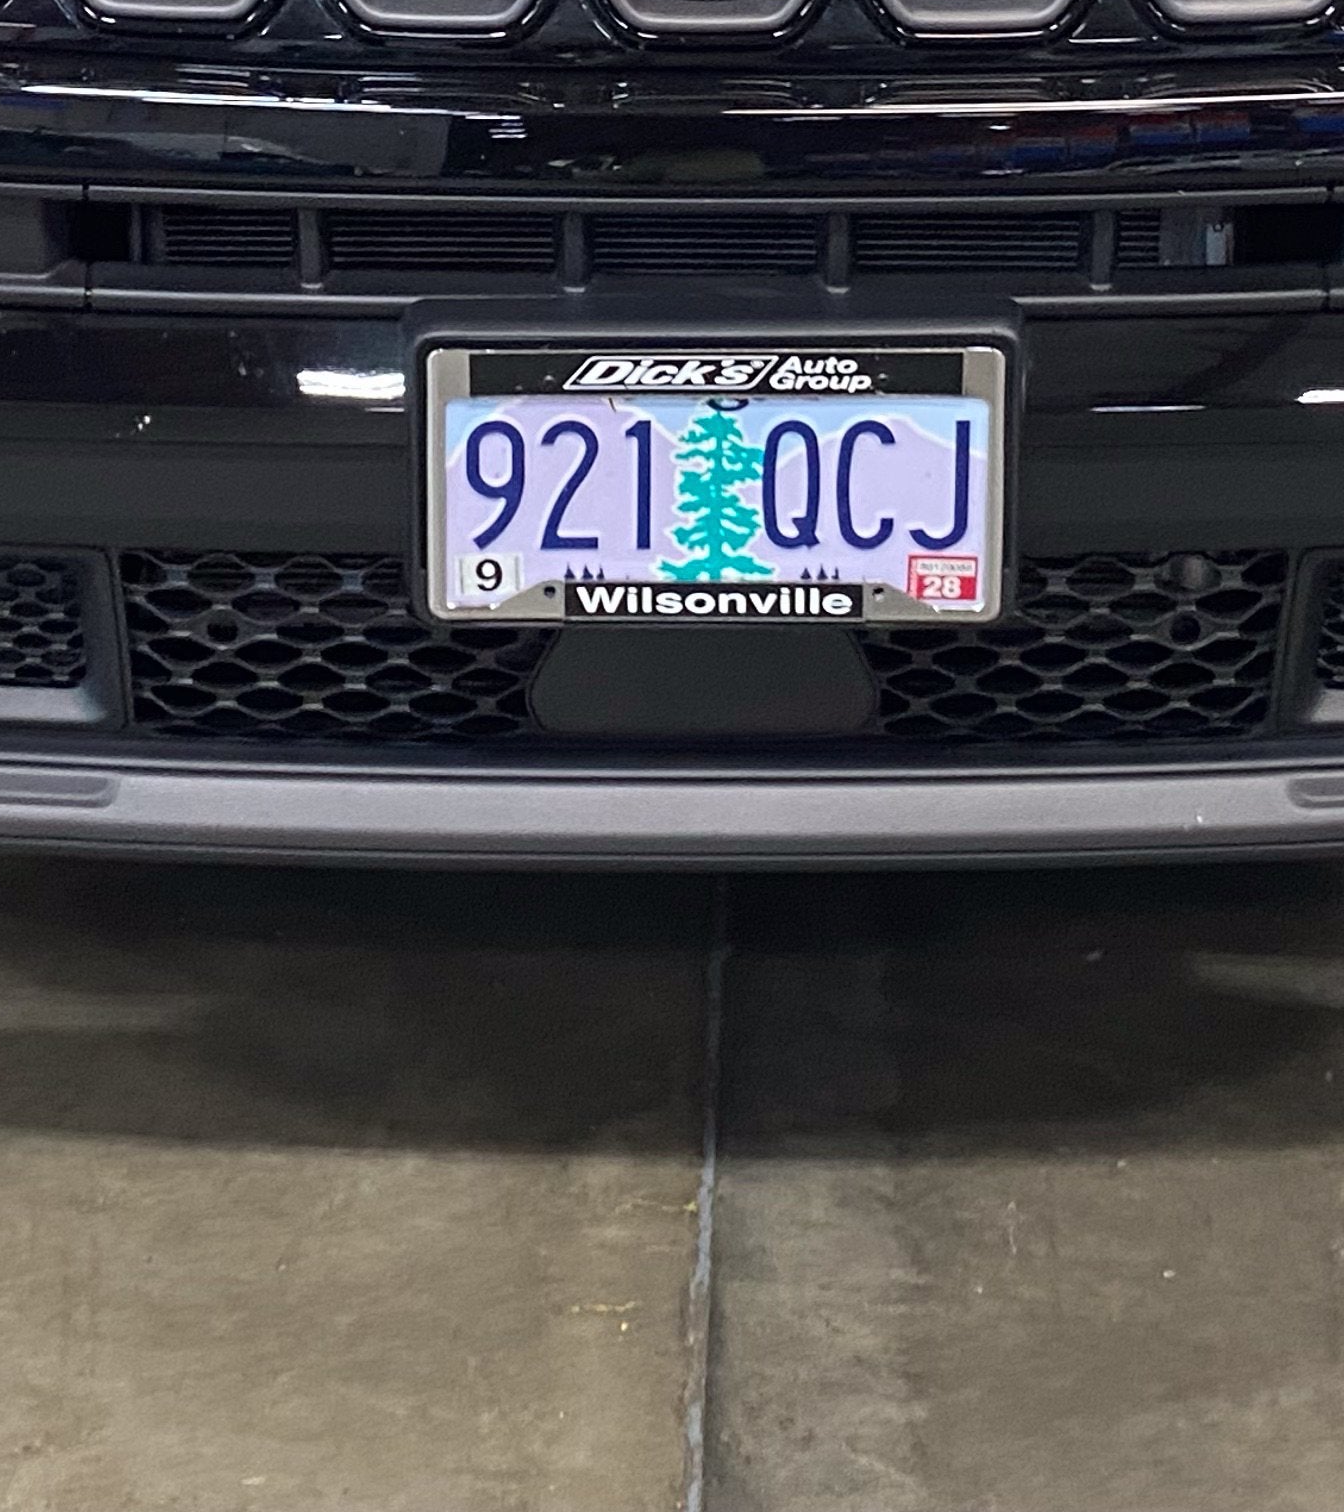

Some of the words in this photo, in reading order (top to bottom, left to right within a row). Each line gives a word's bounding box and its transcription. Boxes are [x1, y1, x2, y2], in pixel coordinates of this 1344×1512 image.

[577, 358, 757, 385] Dick's
[778, 356, 858, 375] Auto
[769, 372, 872, 393] Group
[465, 419, 652, 550] 921
[761, 419, 970, 550] QCJ
[476, 559, 504, 592] 9
[922, 576, 961, 599] 28
[576, 587, 853, 616] Wilsonville
